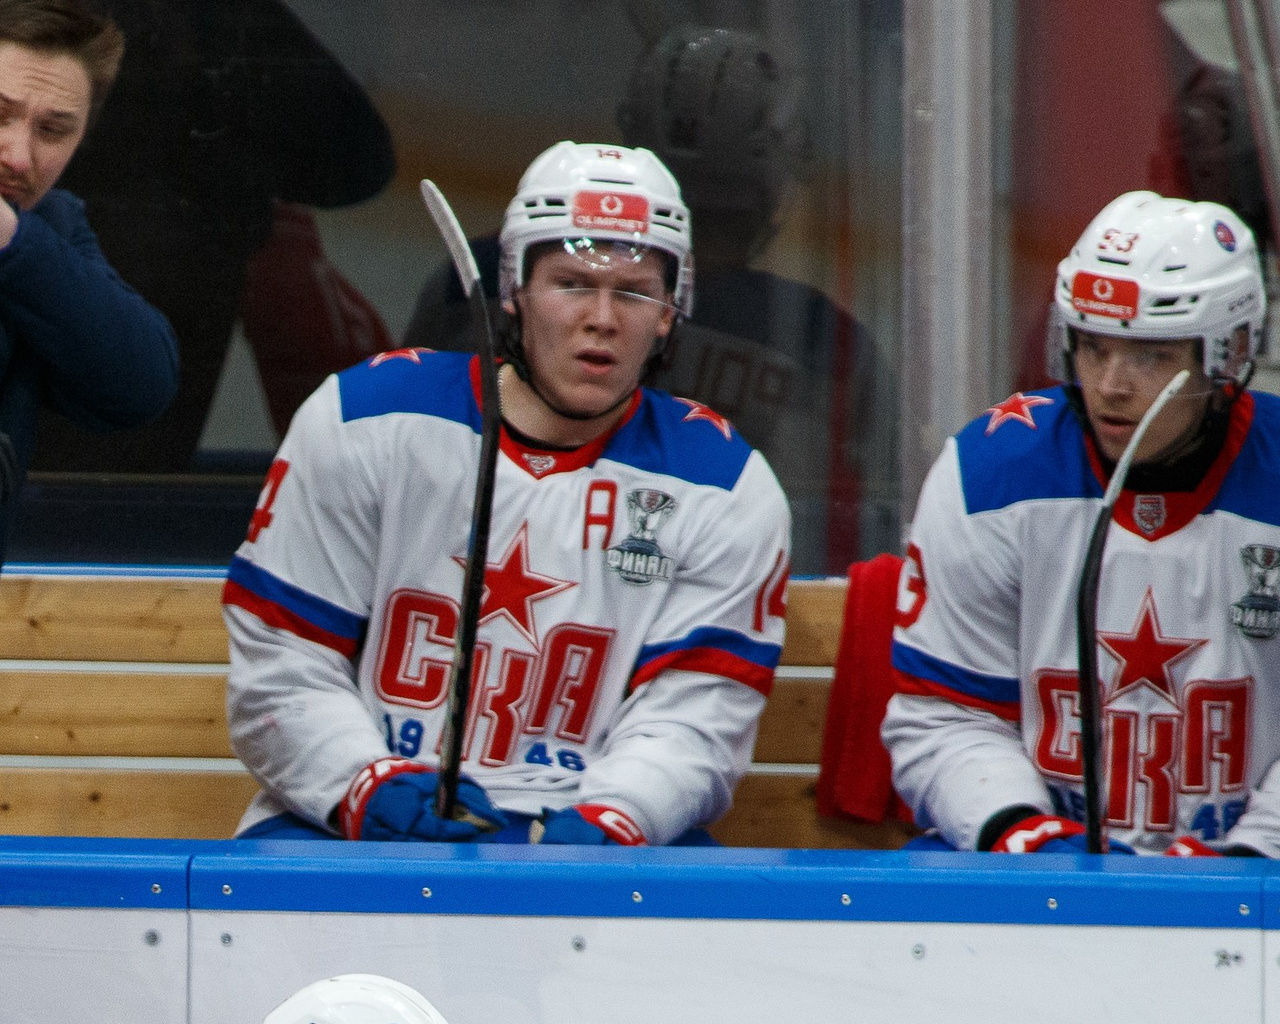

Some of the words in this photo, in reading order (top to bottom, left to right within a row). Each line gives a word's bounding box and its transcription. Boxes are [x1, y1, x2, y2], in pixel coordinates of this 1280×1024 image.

[596, 149, 623, 160] 14
[373, 587, 616, 766] СКА
[524, 742, 586, 772] 46
